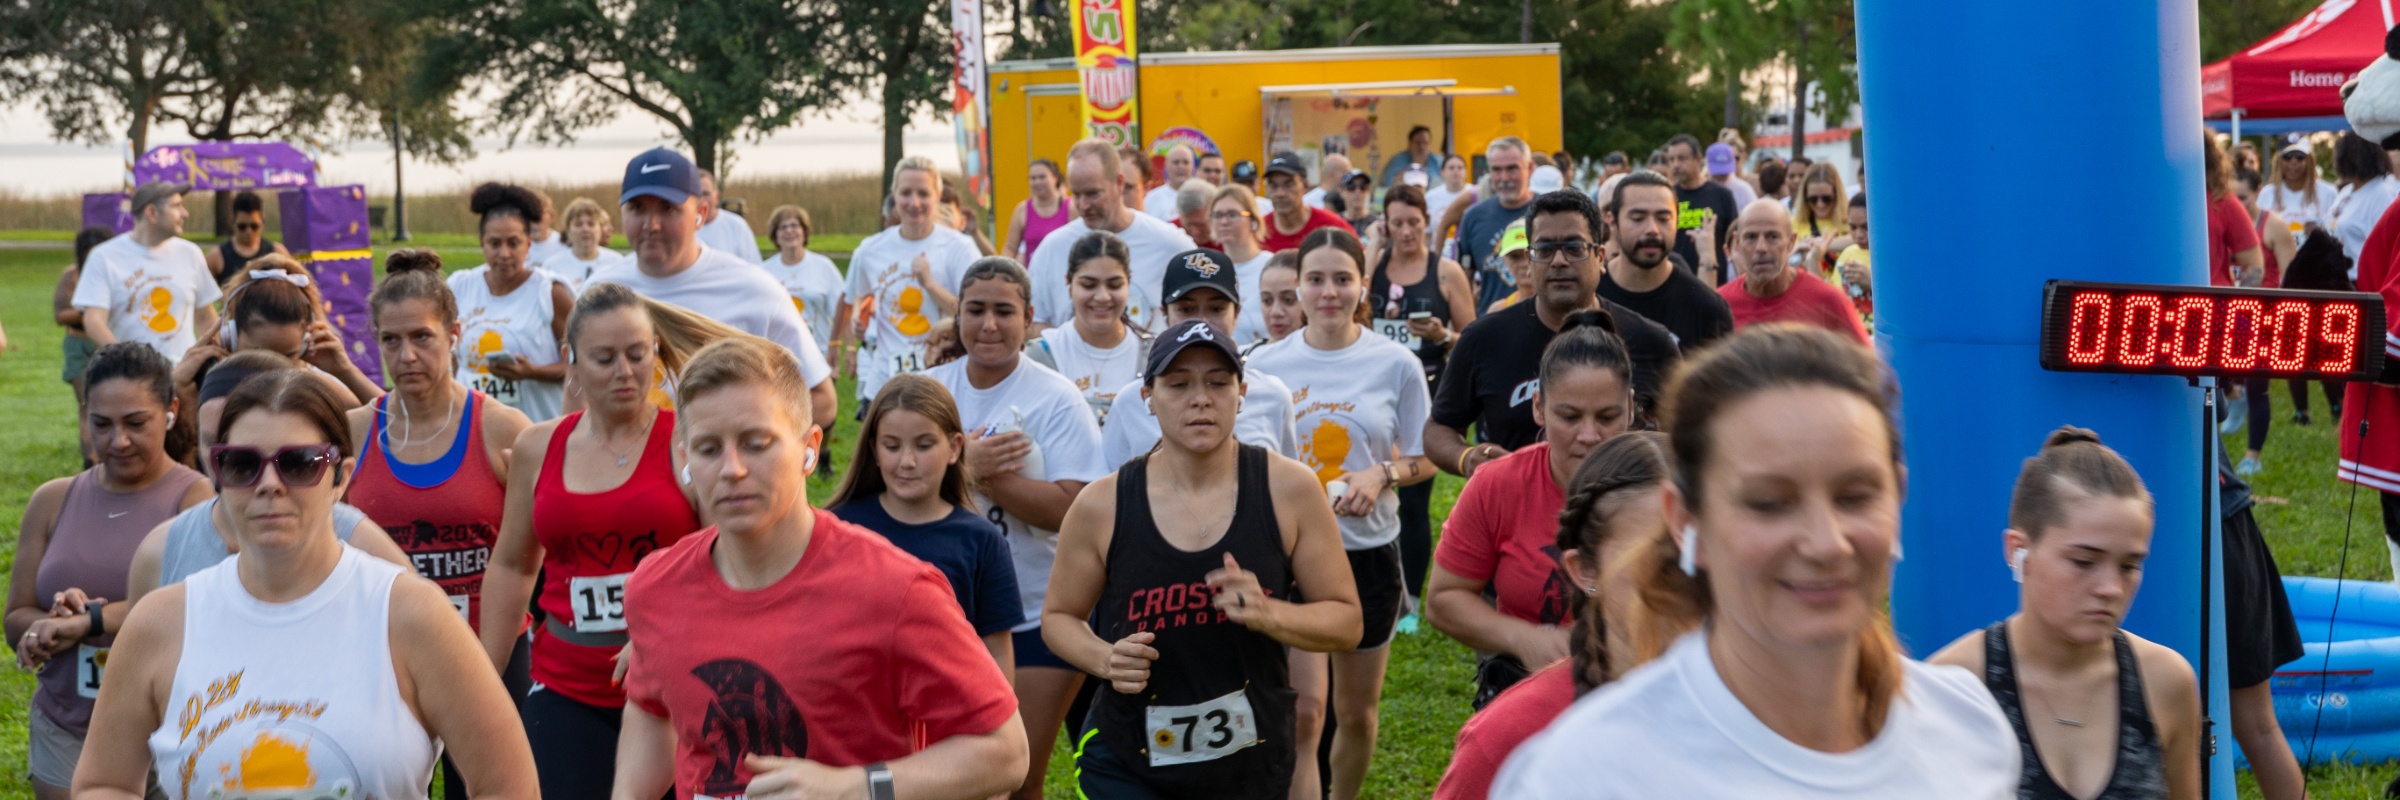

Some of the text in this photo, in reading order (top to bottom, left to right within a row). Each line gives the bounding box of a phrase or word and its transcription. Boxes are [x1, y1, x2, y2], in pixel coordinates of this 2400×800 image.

[2289, 70, 2344, 88] Home
[1183, 252, 1220, 279] UCF
[1384, 324, 1409, 344] 98
[2068, 293, 2358, 372] 00:00:09
[472, 376, 516, 399] 144
[411, 546, 490, 577] ETHER
[1171, 709, 1234, 752] 73
